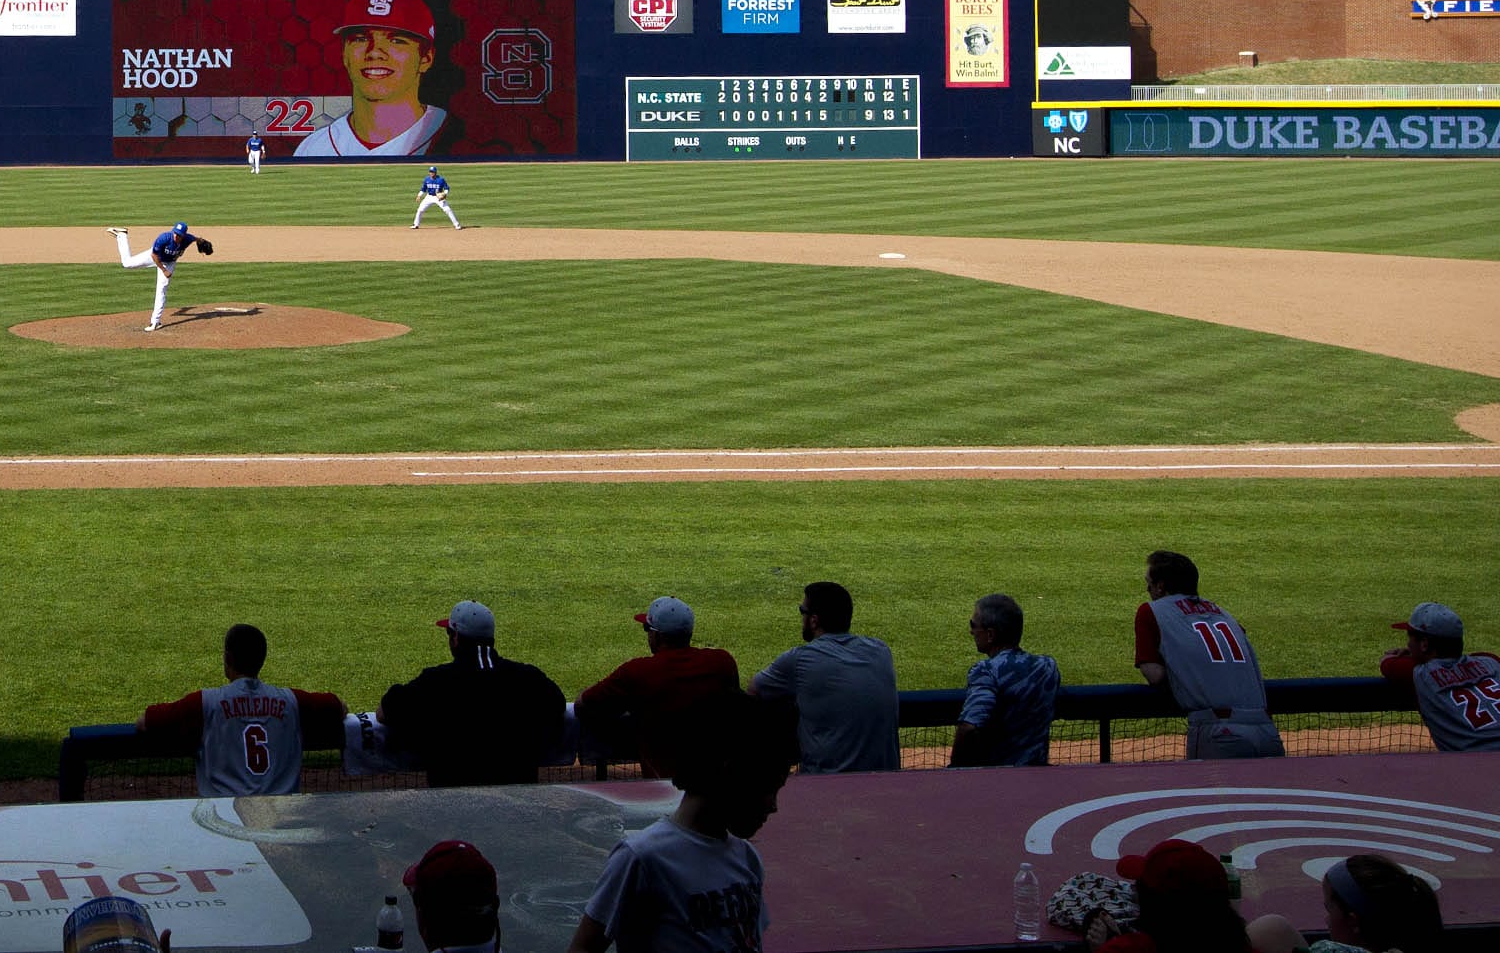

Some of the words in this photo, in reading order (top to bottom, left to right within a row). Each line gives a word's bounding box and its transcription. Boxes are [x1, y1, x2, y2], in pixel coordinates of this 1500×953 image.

[728, 0, 795, 11] FORREST
[962, 4, 993, 15] BEES
[743, 13, 779, 25] FIRM
[122, 49, 233, 68] NATHAN
[959, 60, 972, 68] Hit
[974, 60, 995, 70] Burt,
[122, 68, 198, 88] HOOD
[955, 69, 973, 78] Win
[974, 69, 998, 78] Balm!
[719, 79, 725, 91] 1
[733, 79, 740, 91] 2
[747, 79, 755, 91] 3
[762, 79, 769, 91] 4
[776, 79, 783, 91] 5
[790, 79, 797, 91] 6
[804, 79, 811, 91] 7
[819, 79, 827, 91] 8
[834, 79, 841, 91] 9
[846, 79, 857, 91] 10
[865, 79, 873, 91] R
[884, 79, 892, 91] H
[902, 79, 909, 91] E
[637, 92, 662, 103] N.C.
[665, 92, 702, 103] STATE
[718, 91, 726, 103] 2
[732, 91, 740, 103] 0
[748, 91, 755, 103] 1
[762, 91, 769, 103] 1
[775, 91, 783, 103] 0
[790, 91, 797, 103] 0
[804, 91, 812, 103] 4
[819, 91, 827, 103] 2
[864, 91, 875, 103] 10
[883, 91, 895, 103] 12
[902, 91, 909, 103] 1
[266, 99, 315, 133] 22
[641, 111, 701, 122] DUKE
[719, 110, 725, 121] 1
[732, 110, 740, 121] 0
[747, 110, 755, 121] 0
[761, 110, 769, 121] 0
[776, 110, 783, 121] 1
[791, 110, 797, 121] 1
[805, 110, 811, 121] 1
[819, 110, 827, 121] 5
[864, 110, 873, 121] 9
[883, 110, 895, 121] 13
[902, 110, 909, 121] 1
[1188, 115, 1319, 149] DUKE
[674, 137, 700, 146] BALLS
[727, 137, 760, 146] STRIKES
[785, 136, 807, 145] OUTS
[837, 136, 844, 145] H
[850, 136, 856, 144] E
[1054, 137, 1081, 154] NC
[1192, 621, 1246, 663] 11
[220, 697, 287, 720] RATLEDGE
[243, 723, 271, 776] 6
